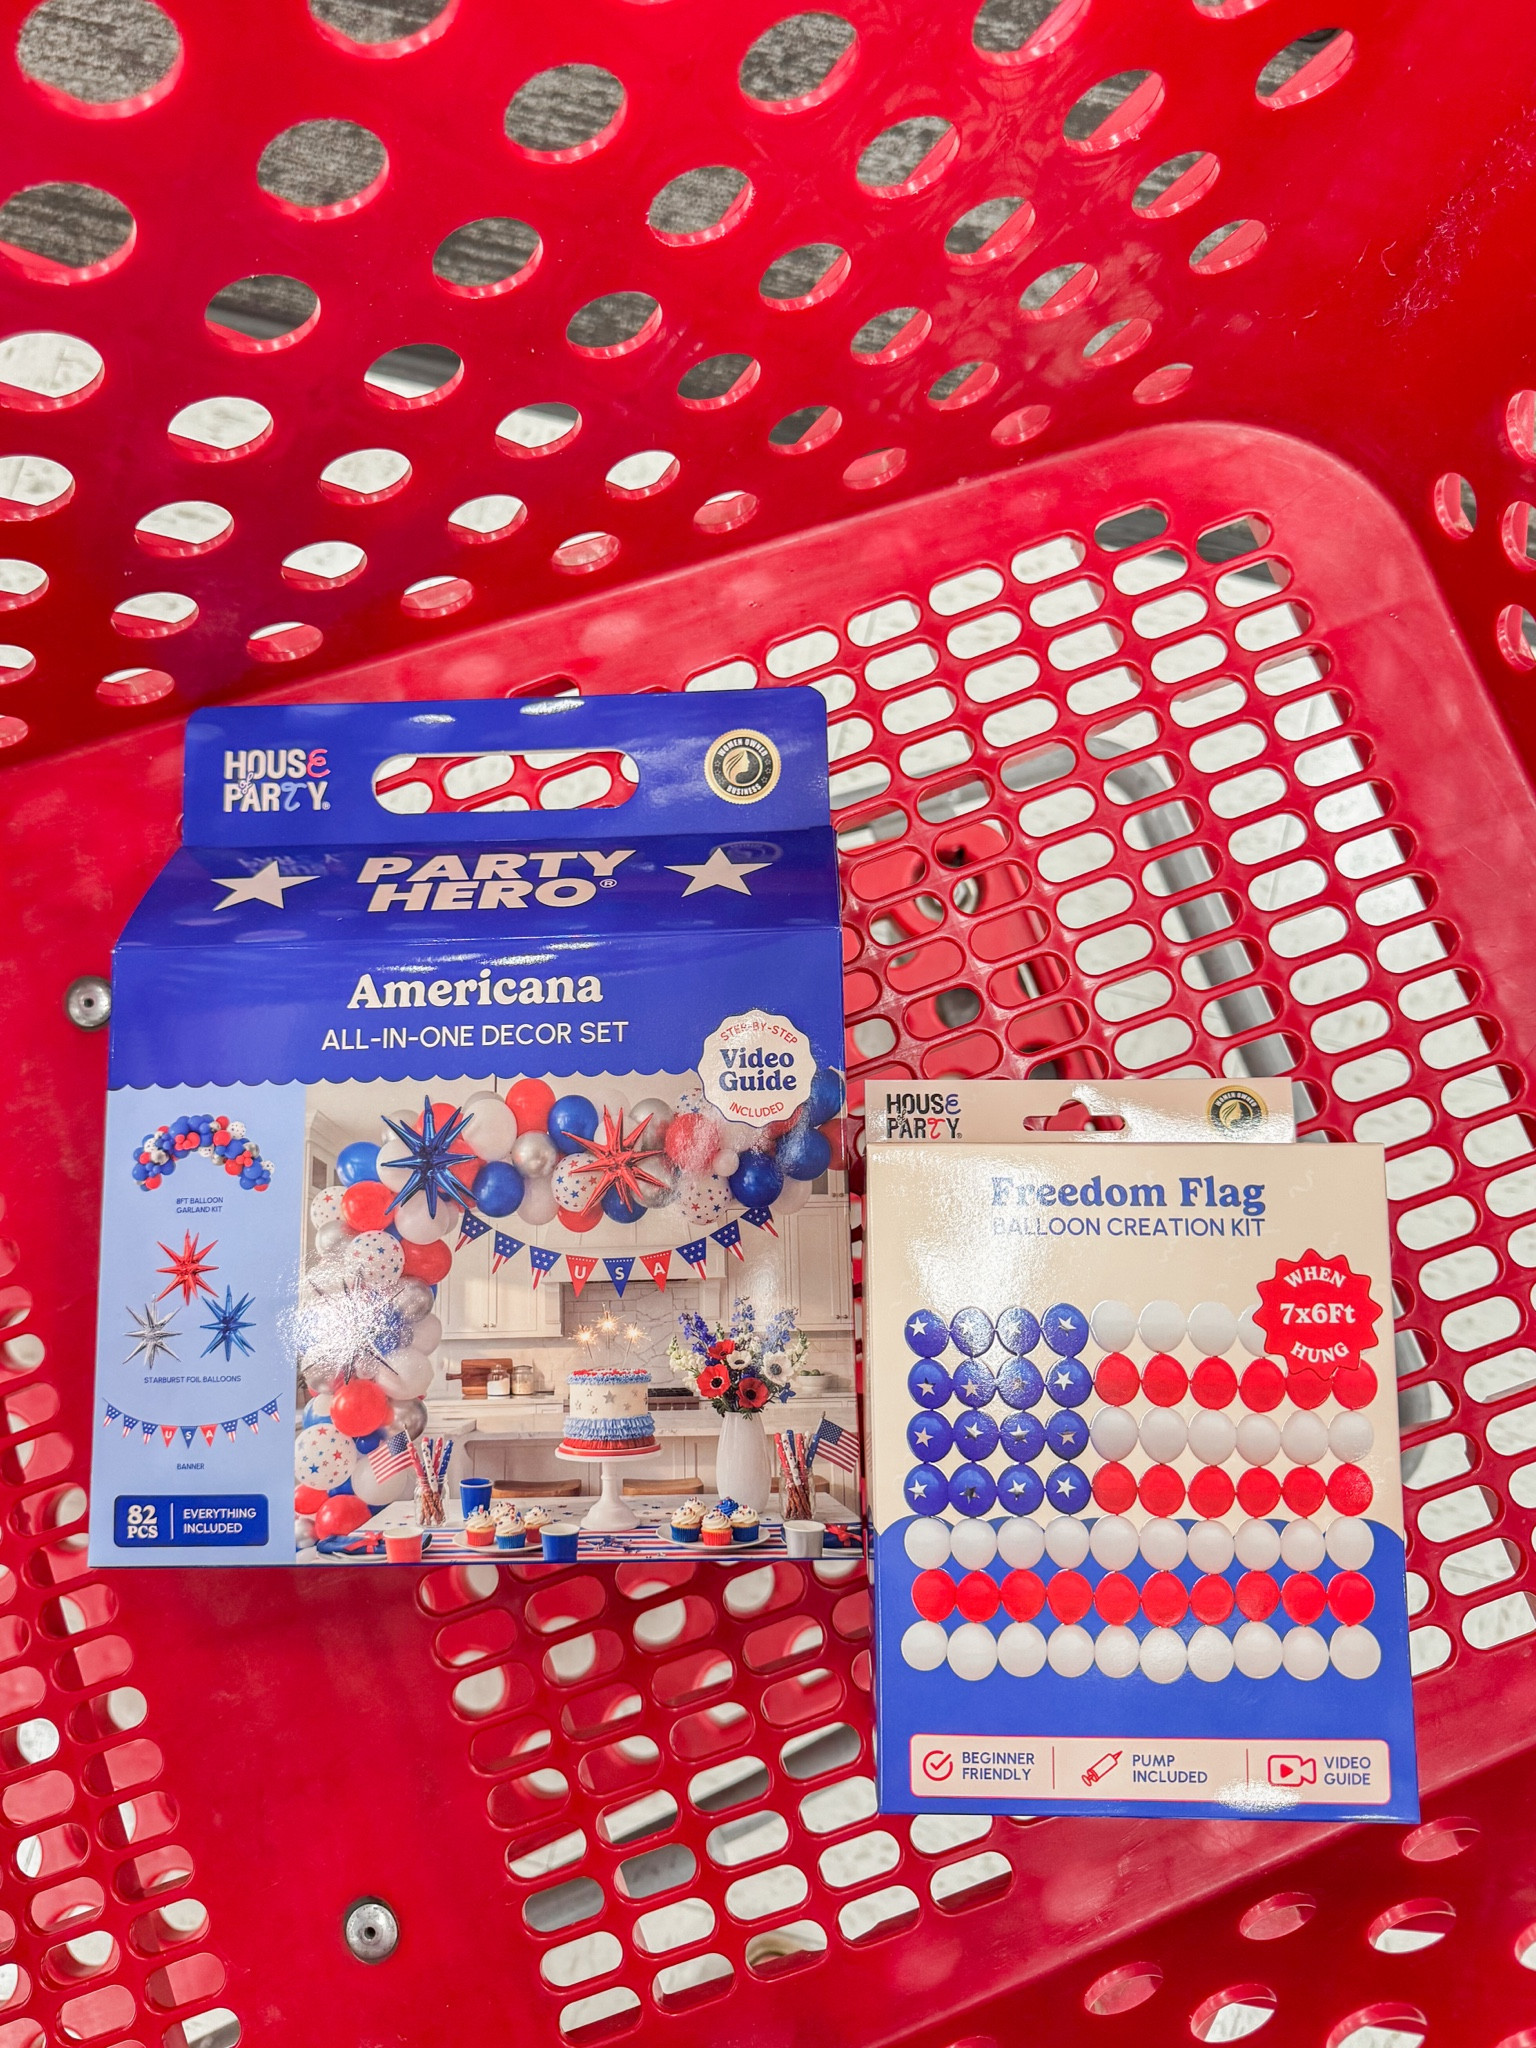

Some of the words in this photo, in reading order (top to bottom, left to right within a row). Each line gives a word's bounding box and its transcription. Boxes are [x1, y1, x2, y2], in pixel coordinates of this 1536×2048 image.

[717, 738, 743, 757] WOMEN
[744, 738, 769, 757] OWNED
[223, 748, 331, 780] HOUSE
[726, 782, 762, 796] BUSINESS
[357, 850, 637, 883] PARTY
[346, 968, 604, 1009] Americana
[321, 1025, 474, 1051] ALL-IN-ONE
[481, 1022, 572, 1046] DECOR
[579, 1020, 630, 1043] SET
[720, 1021, 798, 1044] STEP-BY-STEP
[719, 1047, 794, 1069] Video
[719, 1069, 797, 1092] Guide
[729, 1101, 785, 1118] INCLUDED
[886, 1093, 961, 1115] HOUSE
[189, 1197, 224, 1205] BALLOON
[991, 1175, 1168, 1208] Freedom
[1178, 1175, 1267, 1216] Flag
[176, 1206, 211, 1214] GARLAND
[992, 1217, 1101, 1237] BALLOON
[1107, 1217, 1225, 1237] CREATION
[1231, 1217, 1266, 1237] KIT
[1283, 1265, 1347, 1288] WHEN
[1280, 1302, 1356, 1325] 7x6Ft
[1290, 1340, 1350, 1364] HUNG
[144, 1376, 185, 1384] STARBURST
[202, 1375, 242, 1383] BALLOONS
[127, 1504, 158, 1525] 82
[182, 1508, 257, 1519] EVERYTHING
[127, 1525, 159, 1539] PCS
[182, 1523, 243, 1534] INCLUDED
[962, 1751, 1035, 1765] BEGINNER
[1132, 1754, 1175, 1768] PUMP
[1323, 1756, 1371, 1769] VIDEO
[962, 1767, 1032, 1781] FRIENDLY
[1132, 1769, 1208, 1784] INCLUDED
[1323, 1772, 1371, 1786] GUIDE
